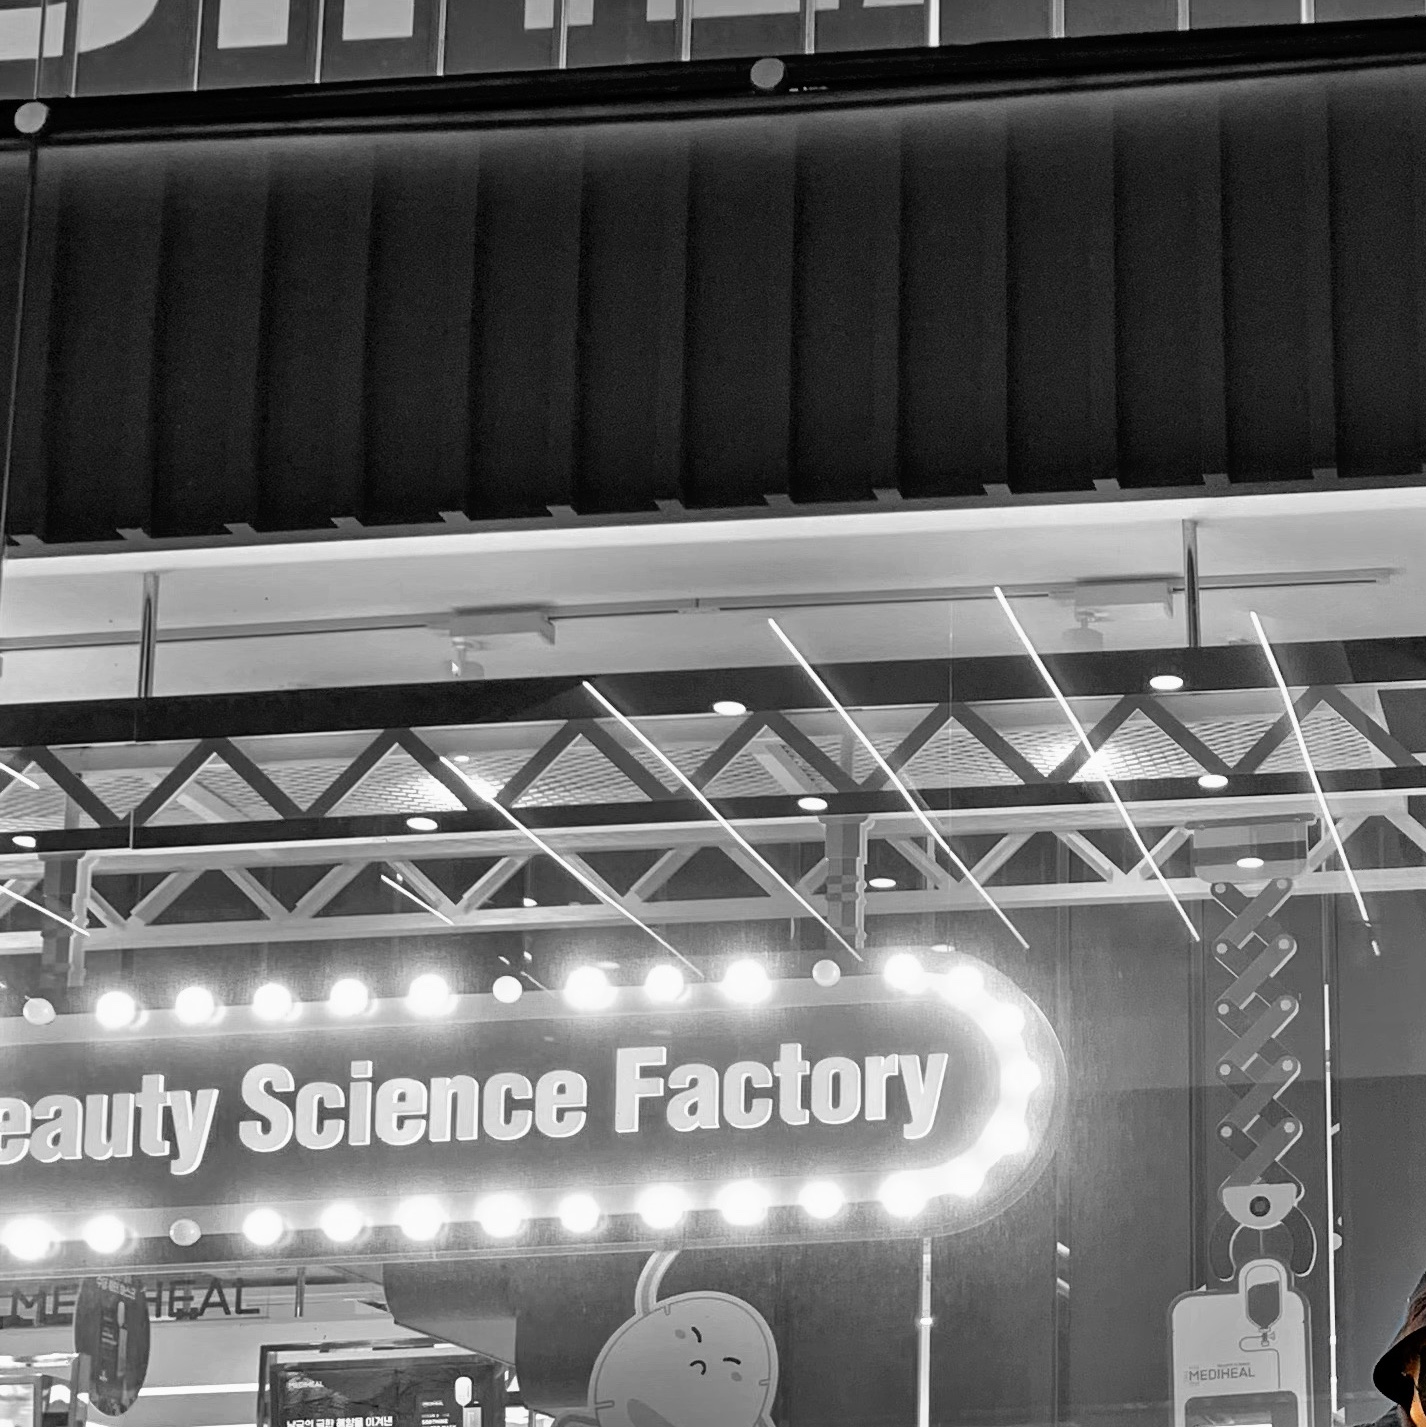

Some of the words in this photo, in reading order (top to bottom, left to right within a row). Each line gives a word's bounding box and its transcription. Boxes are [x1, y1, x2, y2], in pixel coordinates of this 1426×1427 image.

[0, 1073, 219, 1175] eauty
[239, 1060, 588, 1153] Science
[615, 1042, 949, 1140] Factory
[11, 1277, 261, 1328] MEHEAL
[1188, 1365, 1256, 1382] MEDIHEAL
